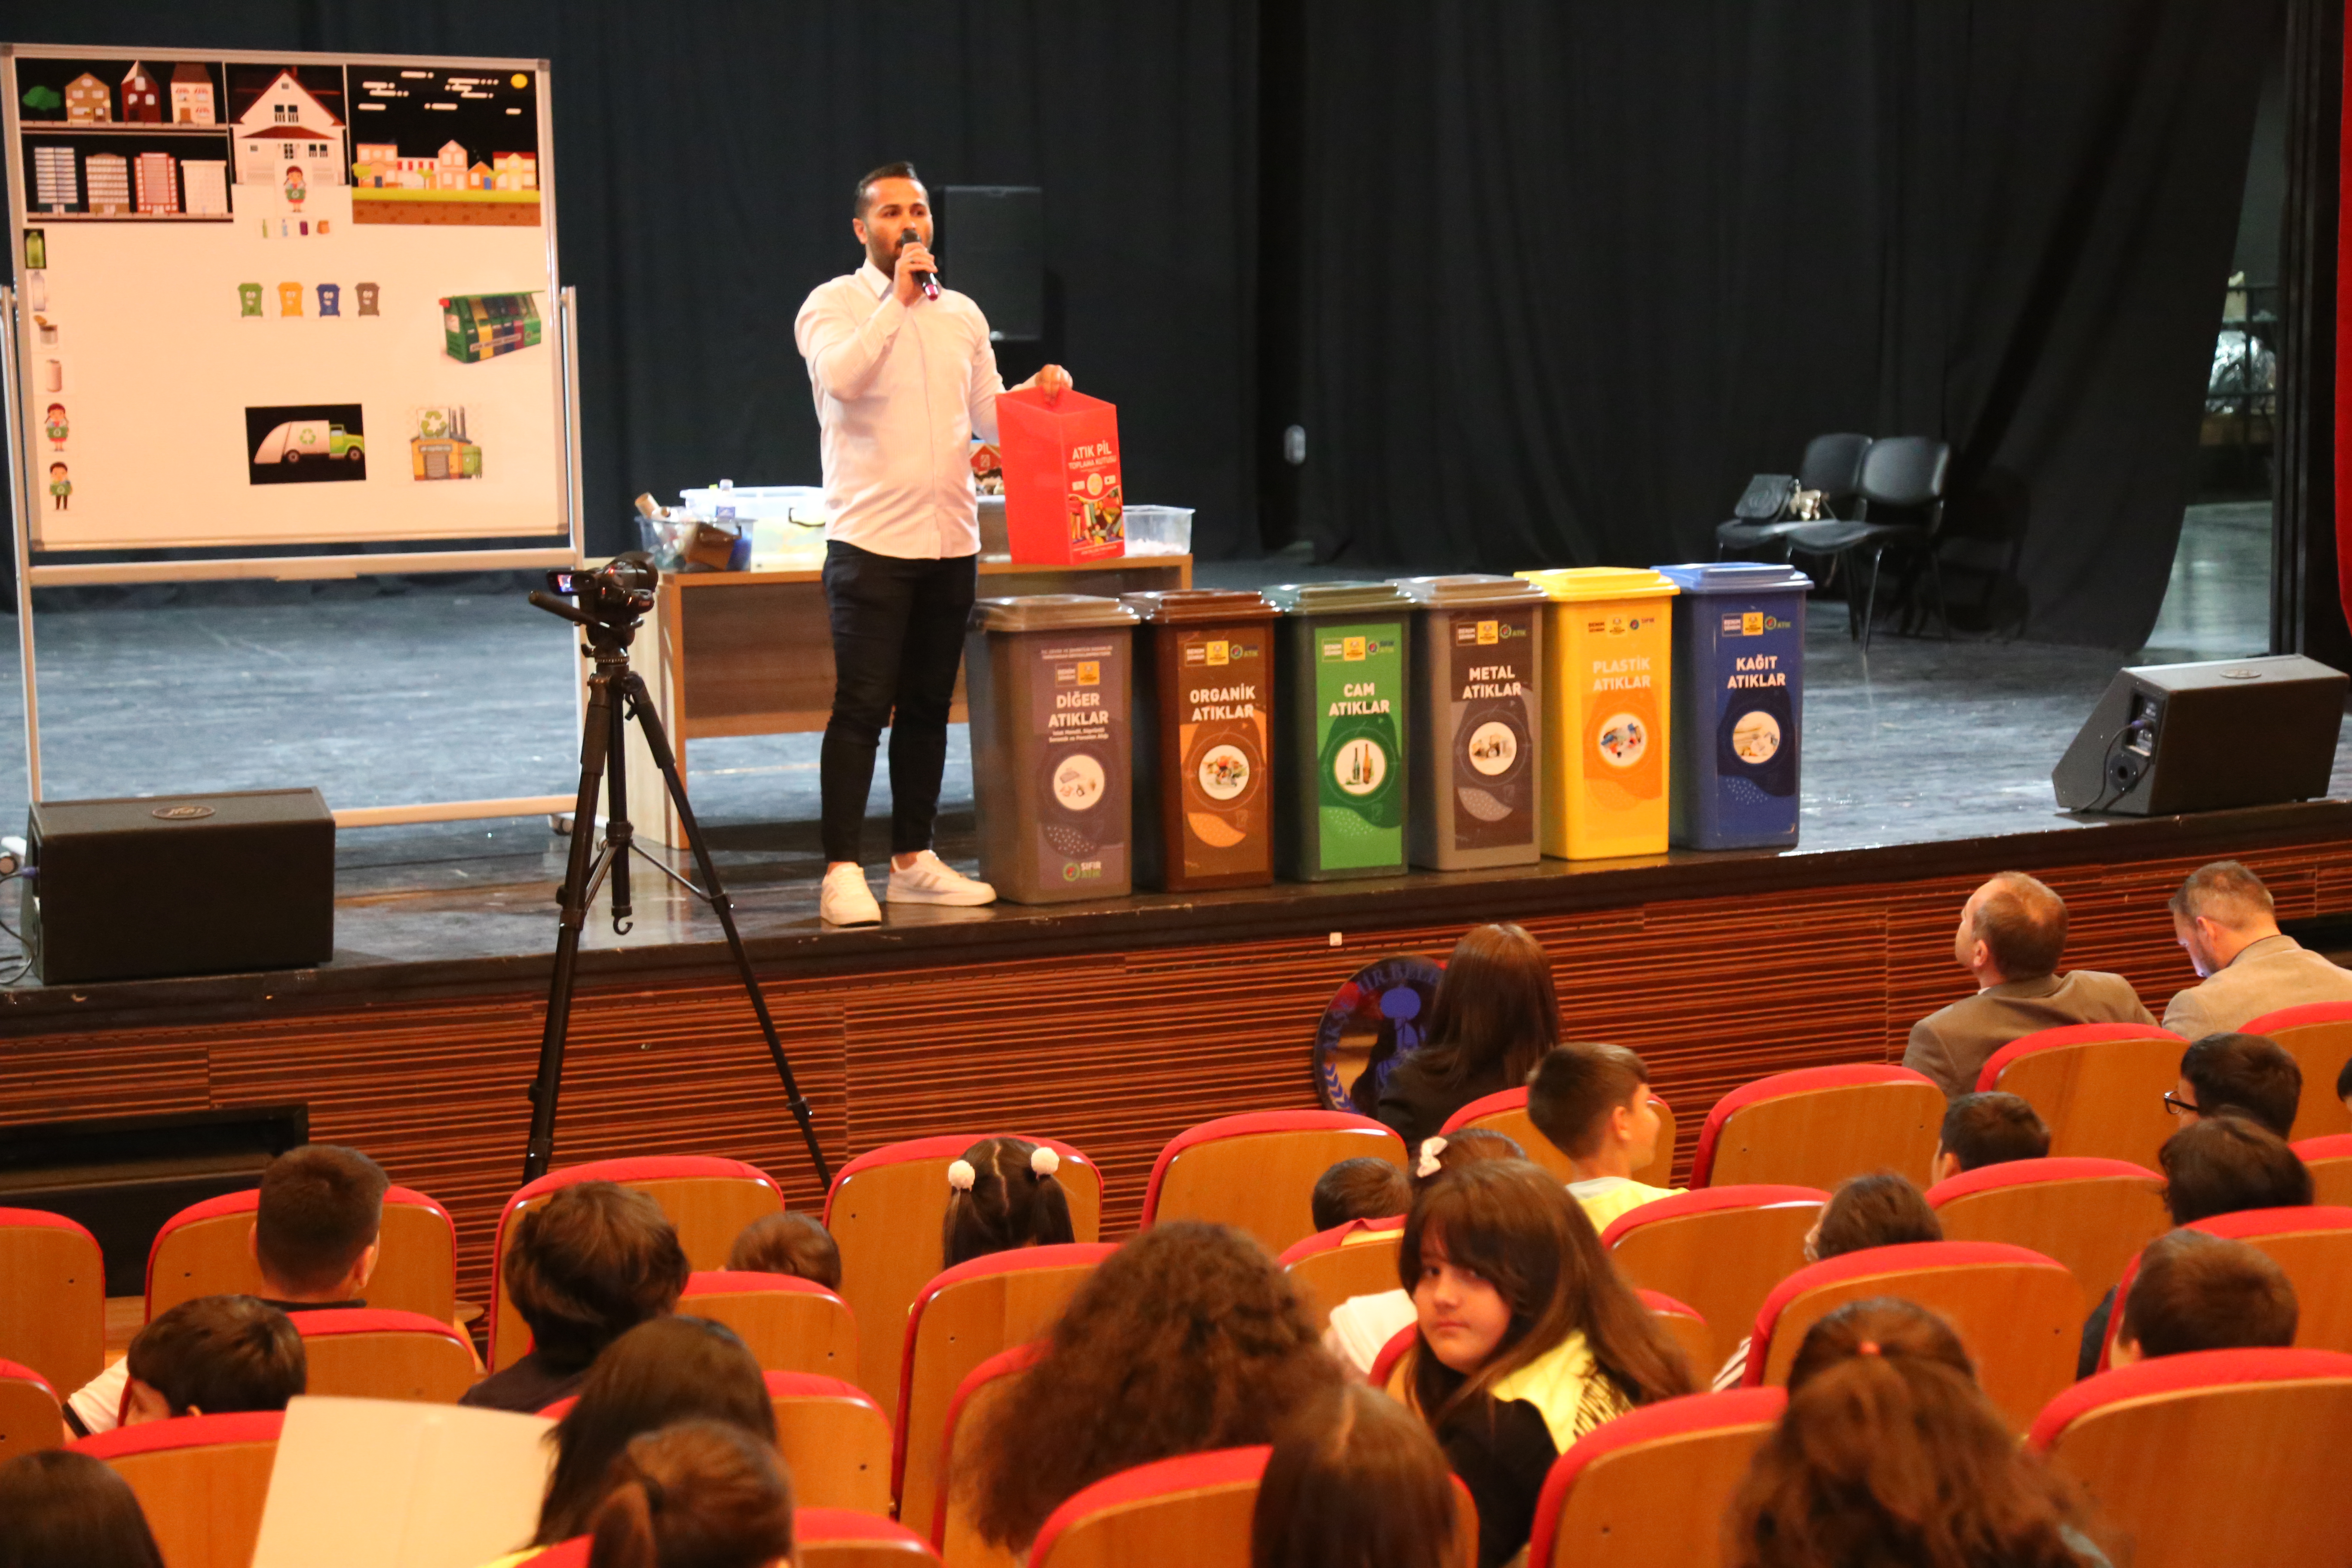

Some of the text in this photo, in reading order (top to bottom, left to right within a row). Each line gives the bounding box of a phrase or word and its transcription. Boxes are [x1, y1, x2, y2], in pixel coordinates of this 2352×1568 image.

[1072, 440, 1112, 460] ATIK PİL
[1593, 654, 1651, 674] PLASTİK
[1736, 653, 1778, 671] KAĞIT
[1469, 665, 1516, 681] METAL
[1727, 673, 1786, 689] ATIKLAR
[1344, 682, 1375, 697] CAM
[1463, 682, 1521, 699] ATIKLAR
[1593, 675, 1651, 692] ATIKLAR
[1056, 691, 1100, 708] DİĞER
[1190, 683, 1256, 704] ORGANİK
[1192, 704, 1254, 722] ATIKLAR
[1329, 699, 1390, 717] ATIKLAR
[1048, 710, 1109, 728] ATIKLAR
